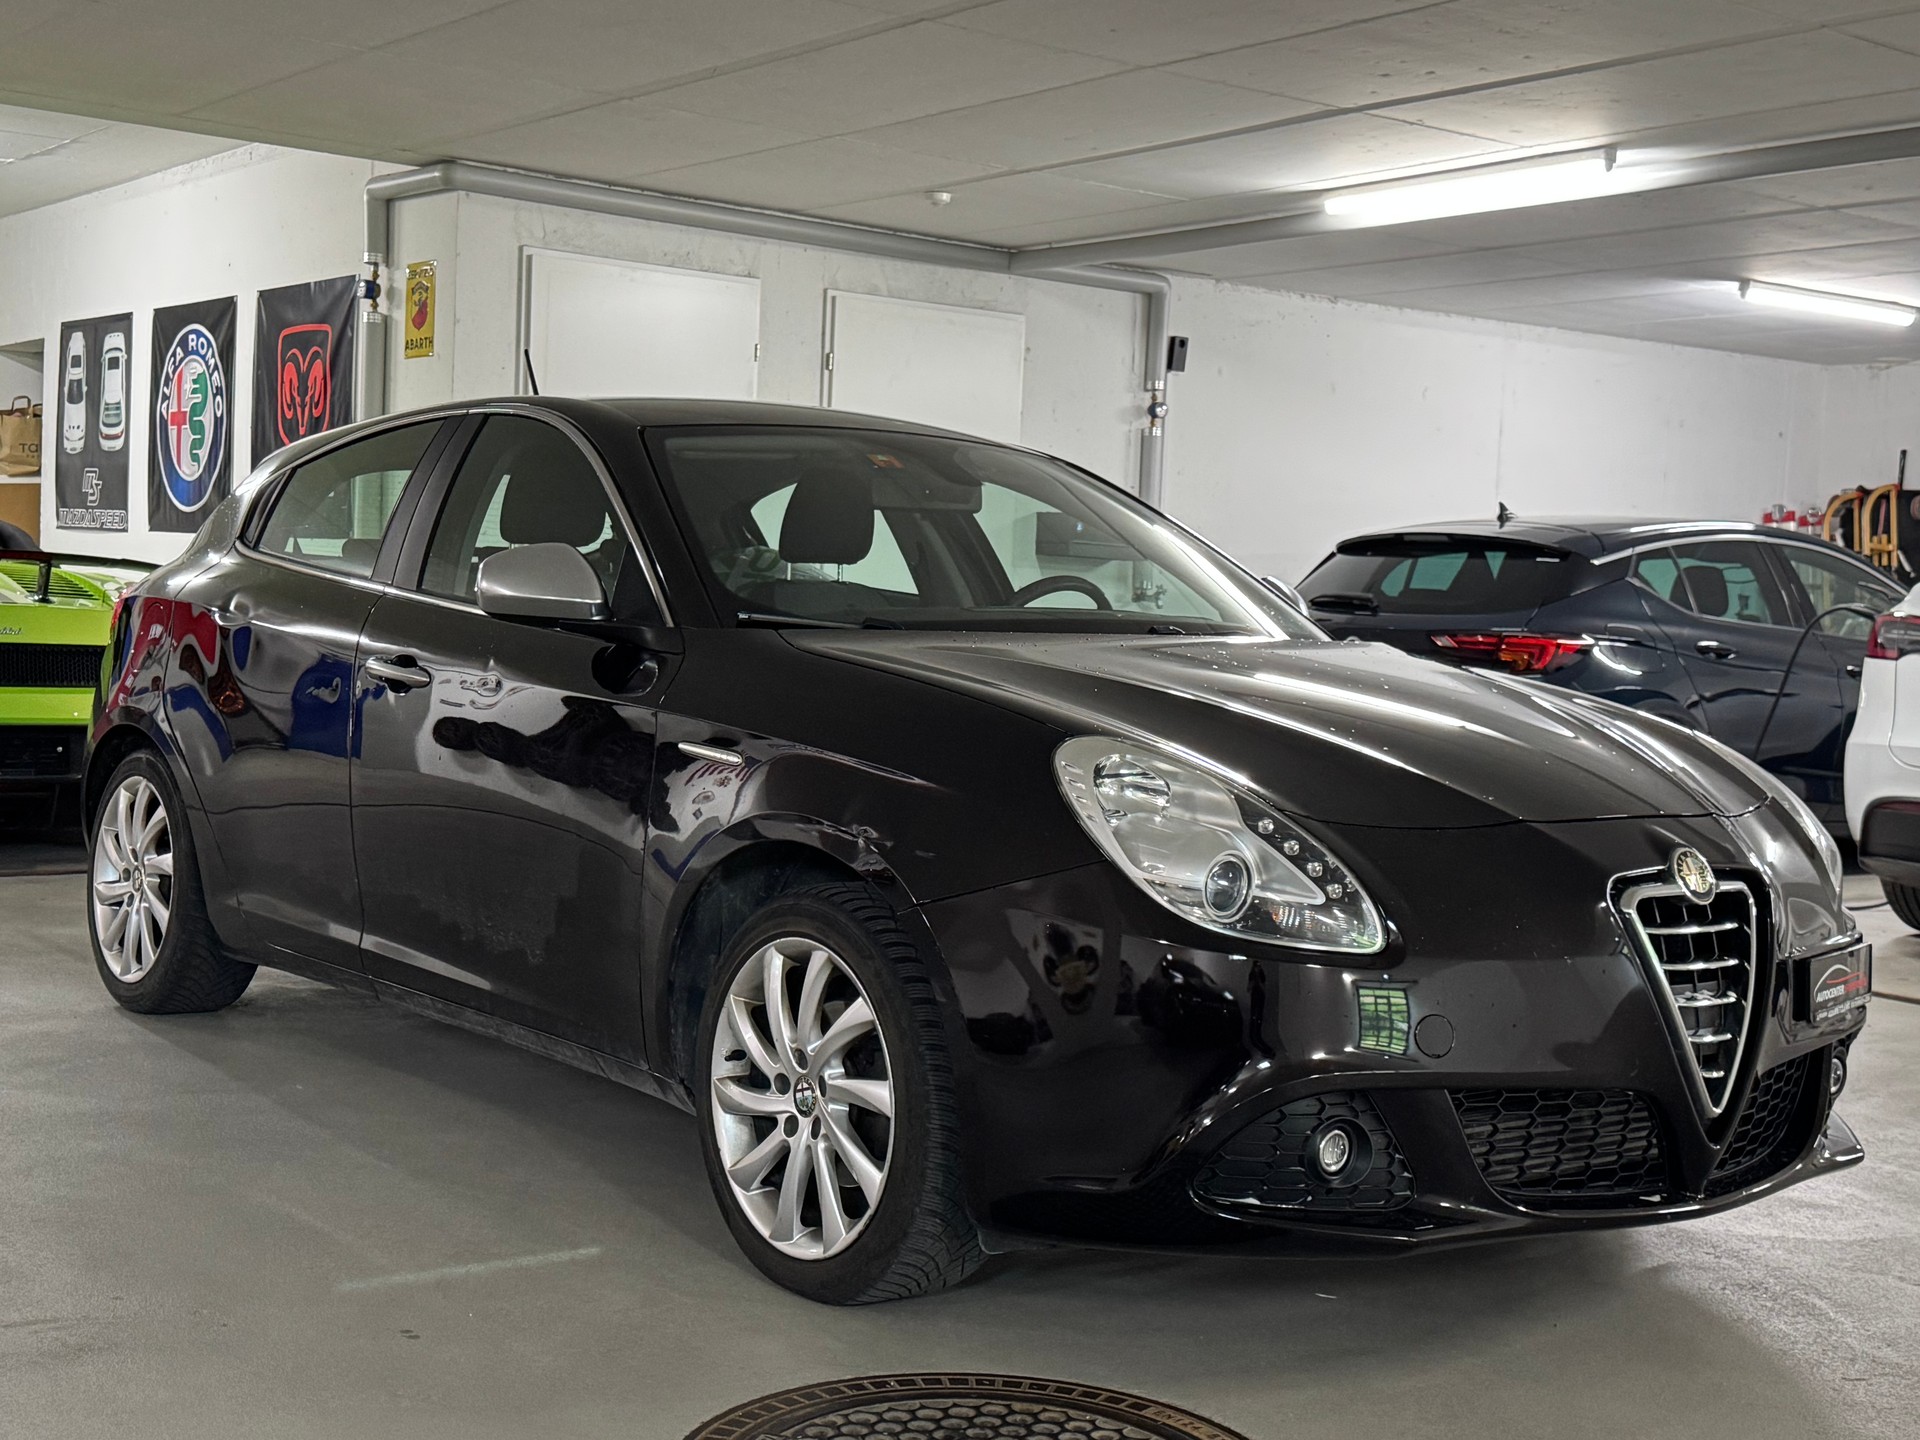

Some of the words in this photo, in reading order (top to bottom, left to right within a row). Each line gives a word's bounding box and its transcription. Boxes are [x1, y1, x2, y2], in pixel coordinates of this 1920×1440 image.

[404, 336, 434, 350] ABARTH
[161, 346, 185, 420] ALFA
[188, 333, 223, 418] ROMEO
[58, 507, 127, 529] MAZDASPEED
[1815, 984, 1845, 1003] AUTOCENTER
